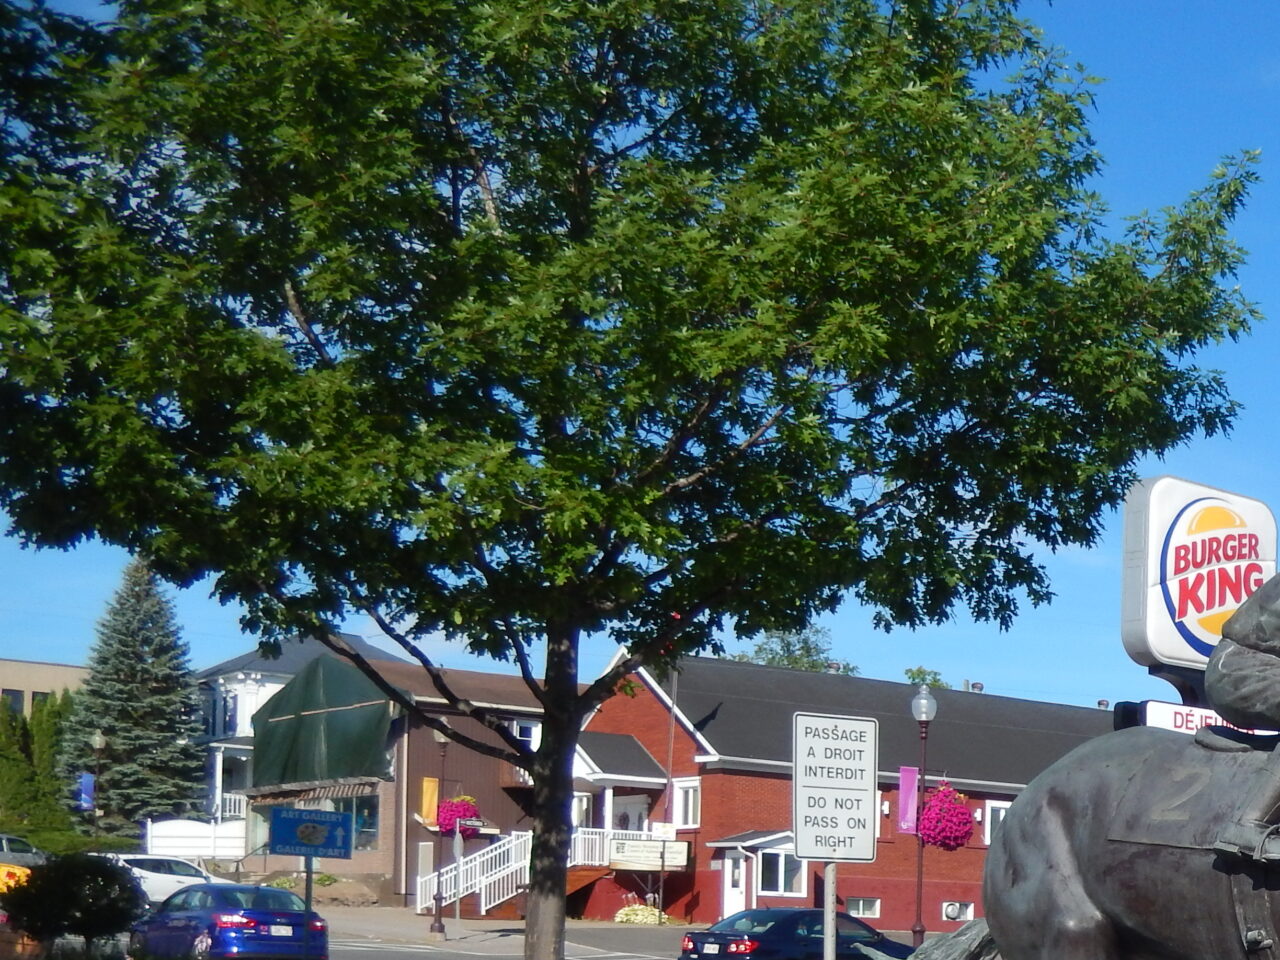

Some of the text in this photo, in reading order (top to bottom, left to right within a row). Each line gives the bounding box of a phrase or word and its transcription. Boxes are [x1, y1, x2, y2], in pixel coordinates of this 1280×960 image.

[1174, 533, 1260, 577] BURGER
[1176, 563, 1264, 620] KING
[804, 726, 867, 743] PASSAGE
[807, 746, 865, 761] A DROIT
[804, 765, 866, 781] INTERDIT
[808, 796, 862, 810] DO NOT
[281, 810, 299, 819] ART
[804, 815, 866, 829] PASS ON
[815, 835, 856, 848] RIGHT
